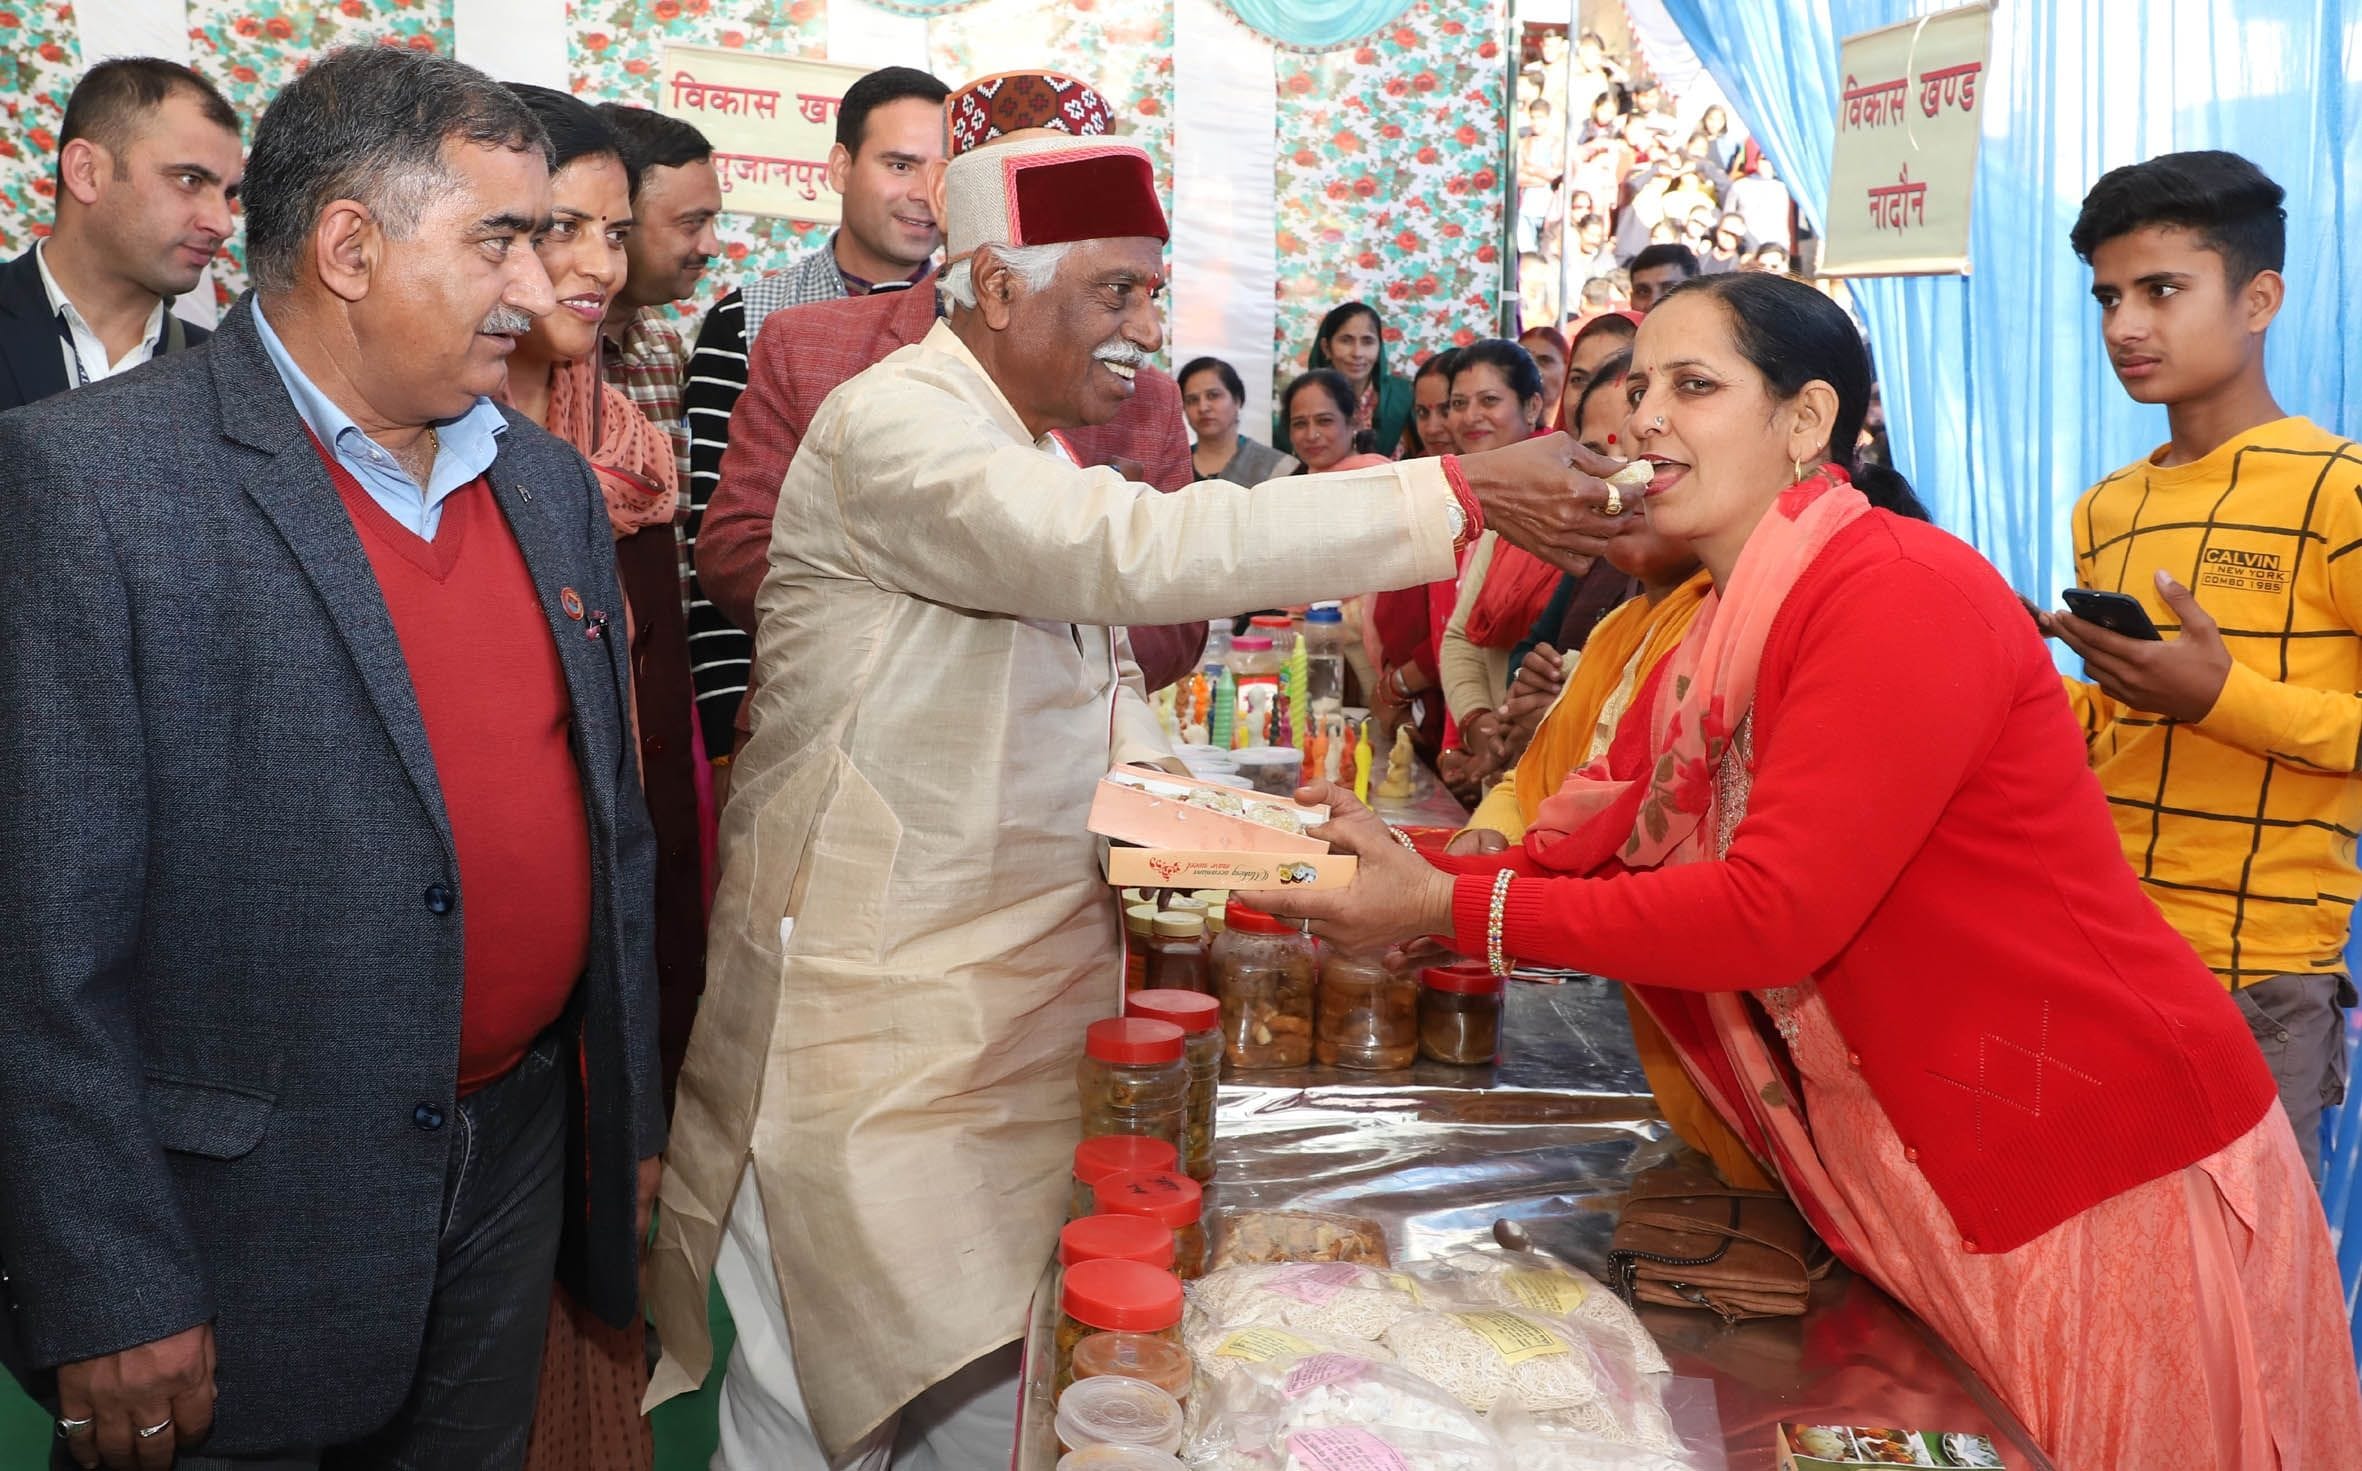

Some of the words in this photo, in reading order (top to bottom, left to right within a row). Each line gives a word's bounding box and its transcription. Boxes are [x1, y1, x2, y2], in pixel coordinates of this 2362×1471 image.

[671, 71, 780, 118] विकास
[1842, 74, 1908, 132] विकास
[1920, 62, 1982, 118] खण्ड
[1868, 162, 1926, 236] नादौन
[2205, 549, 2278, 569] CALVIN
[2217, 566, 2244, 575] NEW
[2250, 570, 2285, 580] YORK
